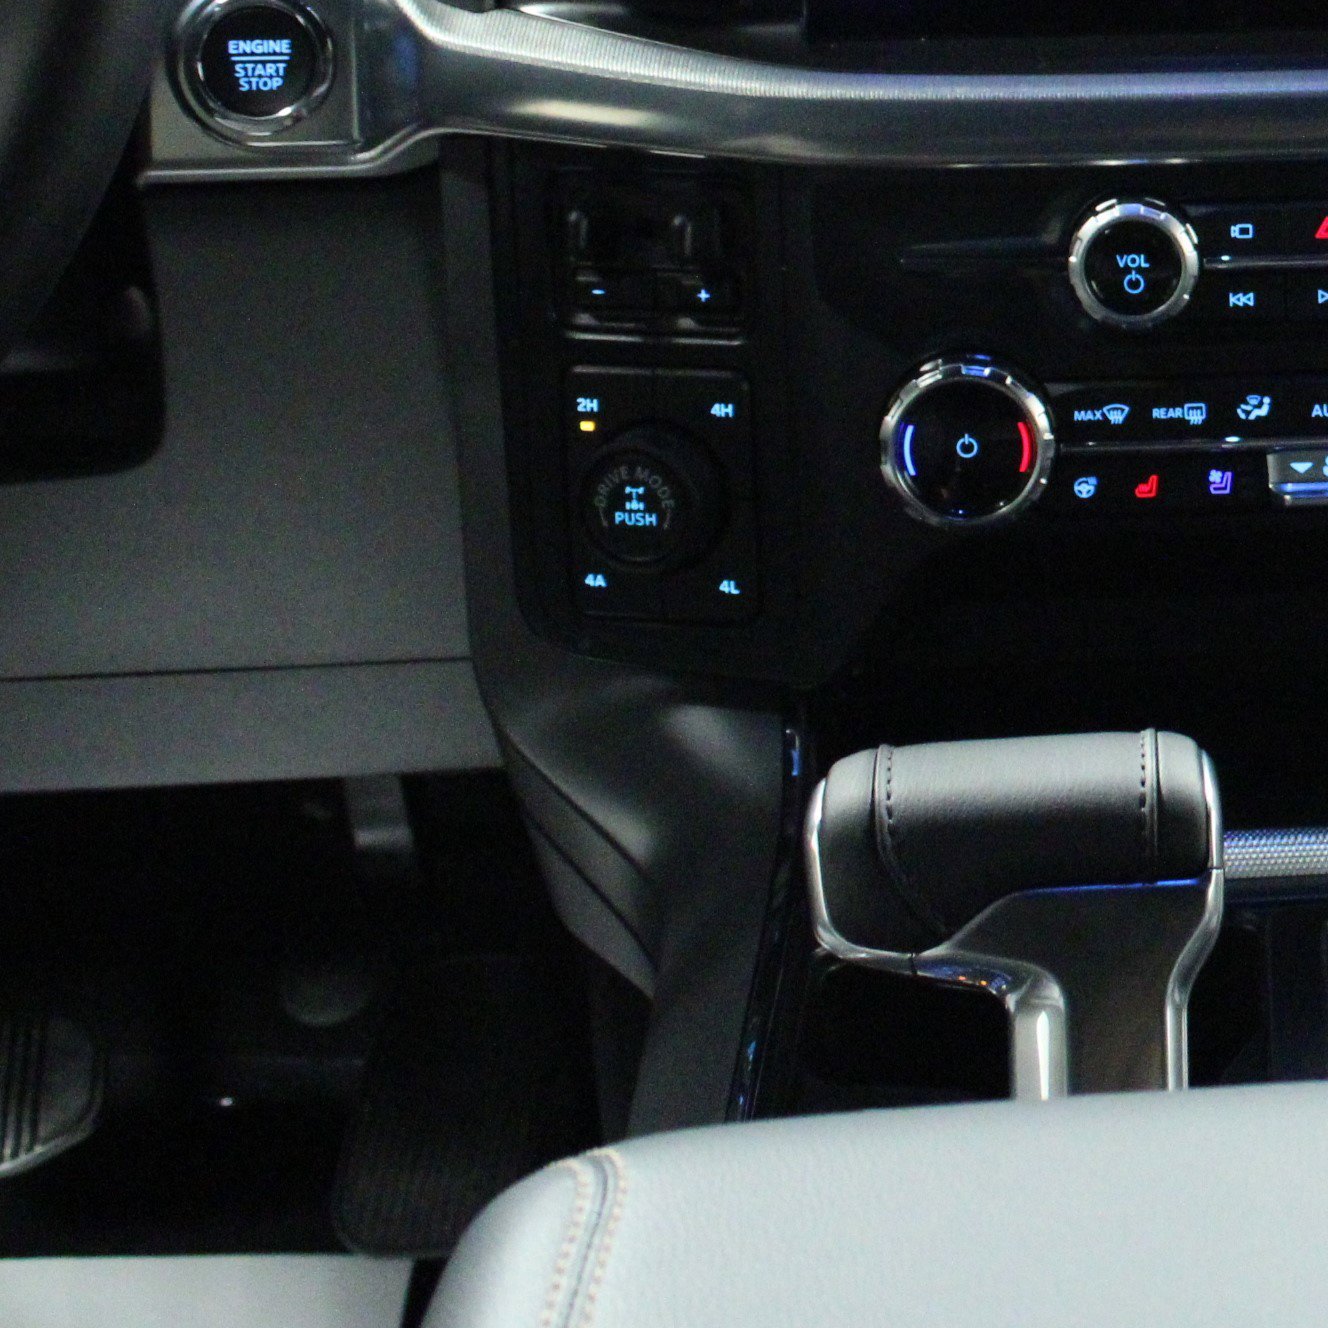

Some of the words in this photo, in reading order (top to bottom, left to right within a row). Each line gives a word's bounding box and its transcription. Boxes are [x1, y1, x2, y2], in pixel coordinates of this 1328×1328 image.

[227, 39, 292, 54] ENGINE
[234, 63, 287, 78] START
[239, 77, 284, 92] STOP
[1116, 254, 1149, 268] VOL
[576, 397, 598, 413] 2H
[710, 402, 734, 418] 4H
[1074, 409, 1102, 421] MAX
[1152, 407, 1183, 420] REAR
[614, 512, 658, 527] PUSH
[585, 573, 607, 588] 4A
[719, 579, 740, 595] 4L
